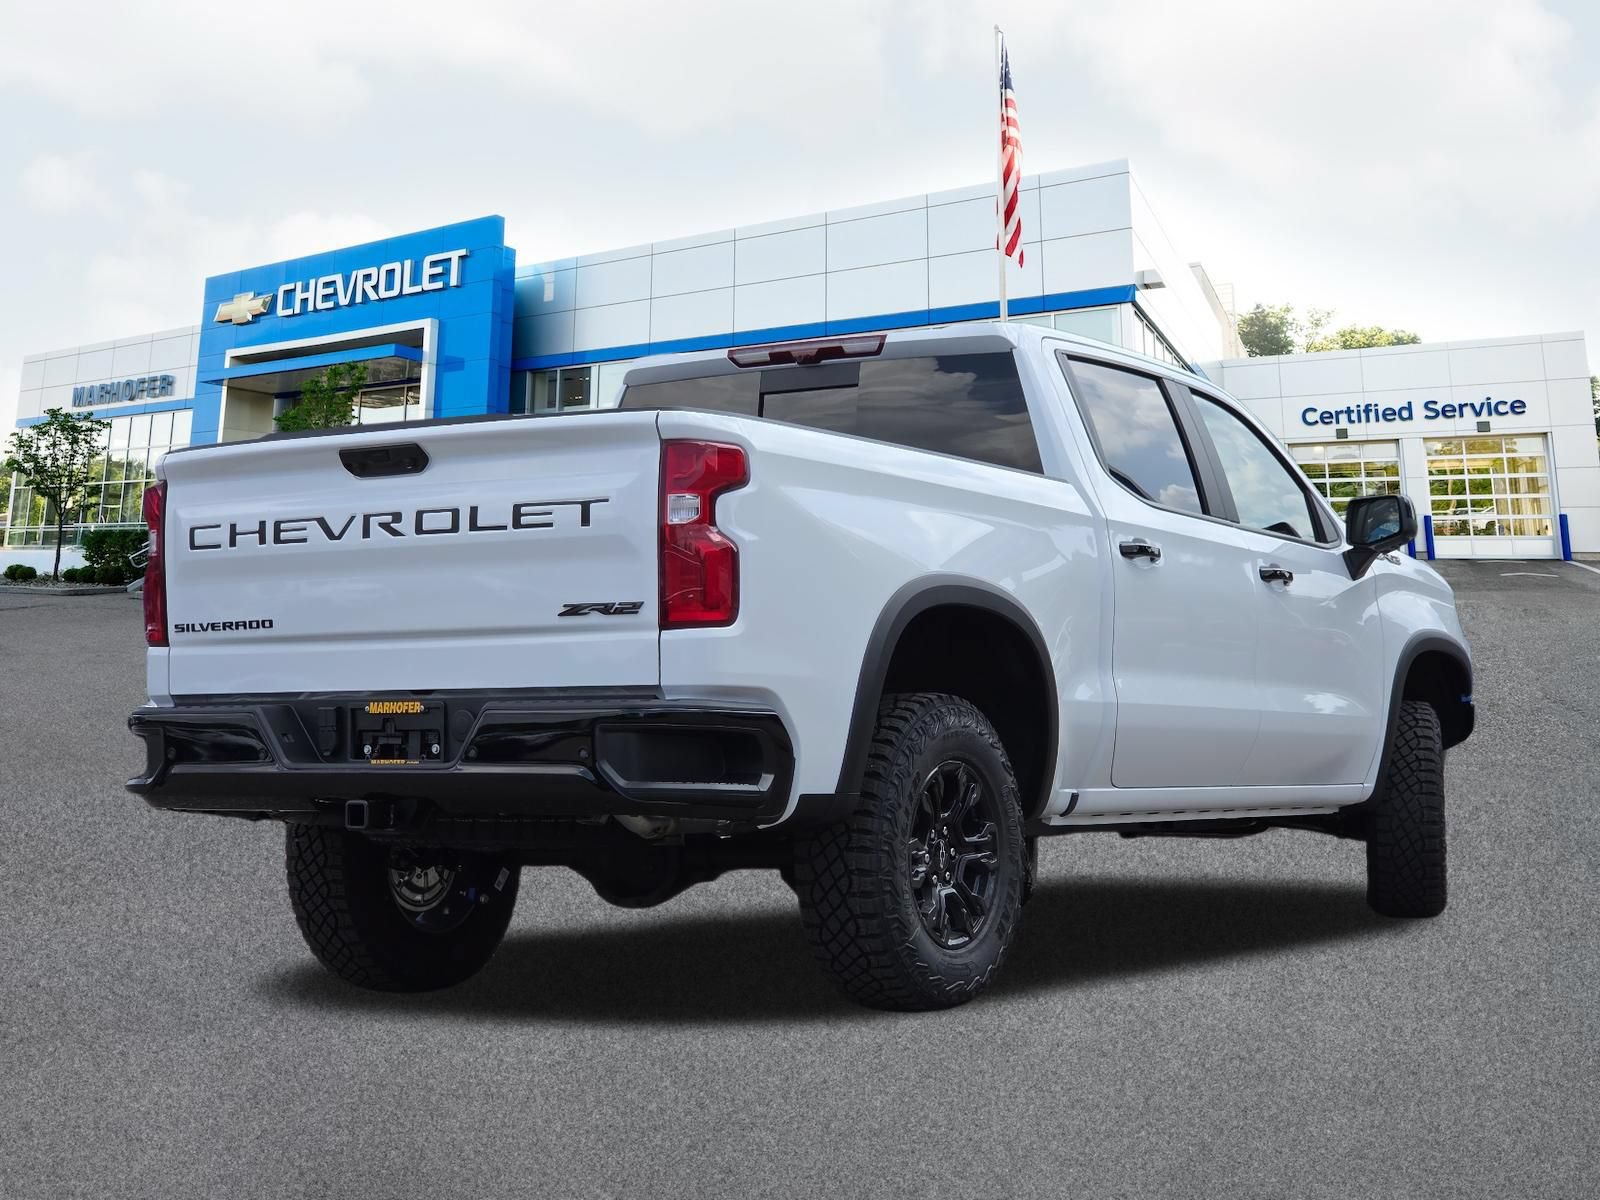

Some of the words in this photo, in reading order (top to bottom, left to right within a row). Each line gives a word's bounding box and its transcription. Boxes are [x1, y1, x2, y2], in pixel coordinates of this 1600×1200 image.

[277, 248, 469, 317] CHEVROLET
[72, 374, 175, 407] MARHOFER
[1301, 401, 1413, 426] Certified
[1423, 397, 1527, 420] Service
[189, 498, 609, 551] CHEVROLET
[557, 601, 644, 616] ZR2
[174, 619, 273, 633] SILVERADO
[369, 701, 421, 714] MARHOFER
